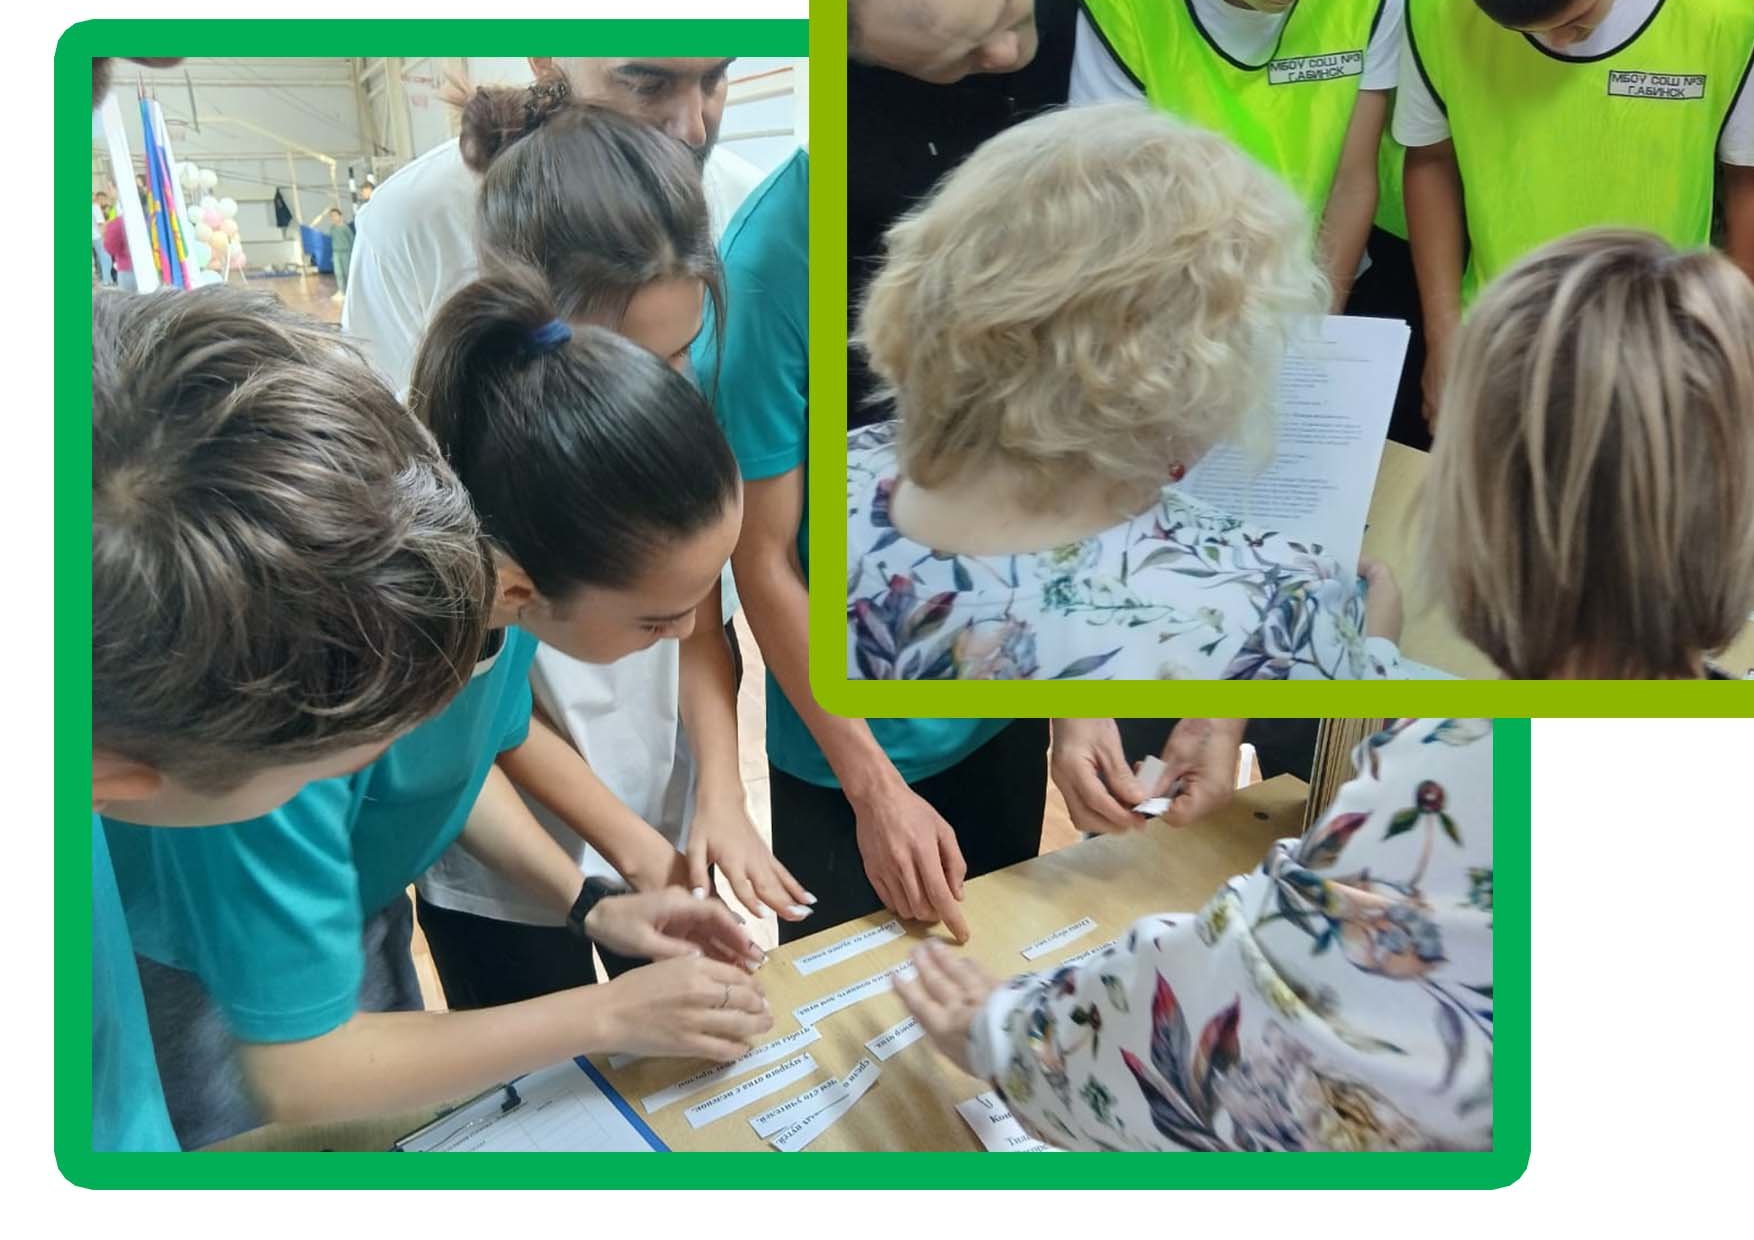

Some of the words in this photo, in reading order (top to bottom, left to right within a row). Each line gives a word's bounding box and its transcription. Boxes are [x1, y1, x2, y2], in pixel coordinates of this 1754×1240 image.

[1270, 60, 1305, 72] МБОУ
[1309, 57, 1337, 68] СОШ
[1341, 53, 1360, 64] №3
[1611, 73, 1647, 84] МБОУ
[1651, 76, 1680, 86] СОШ
[1684, 77, 1704, 86] №3
